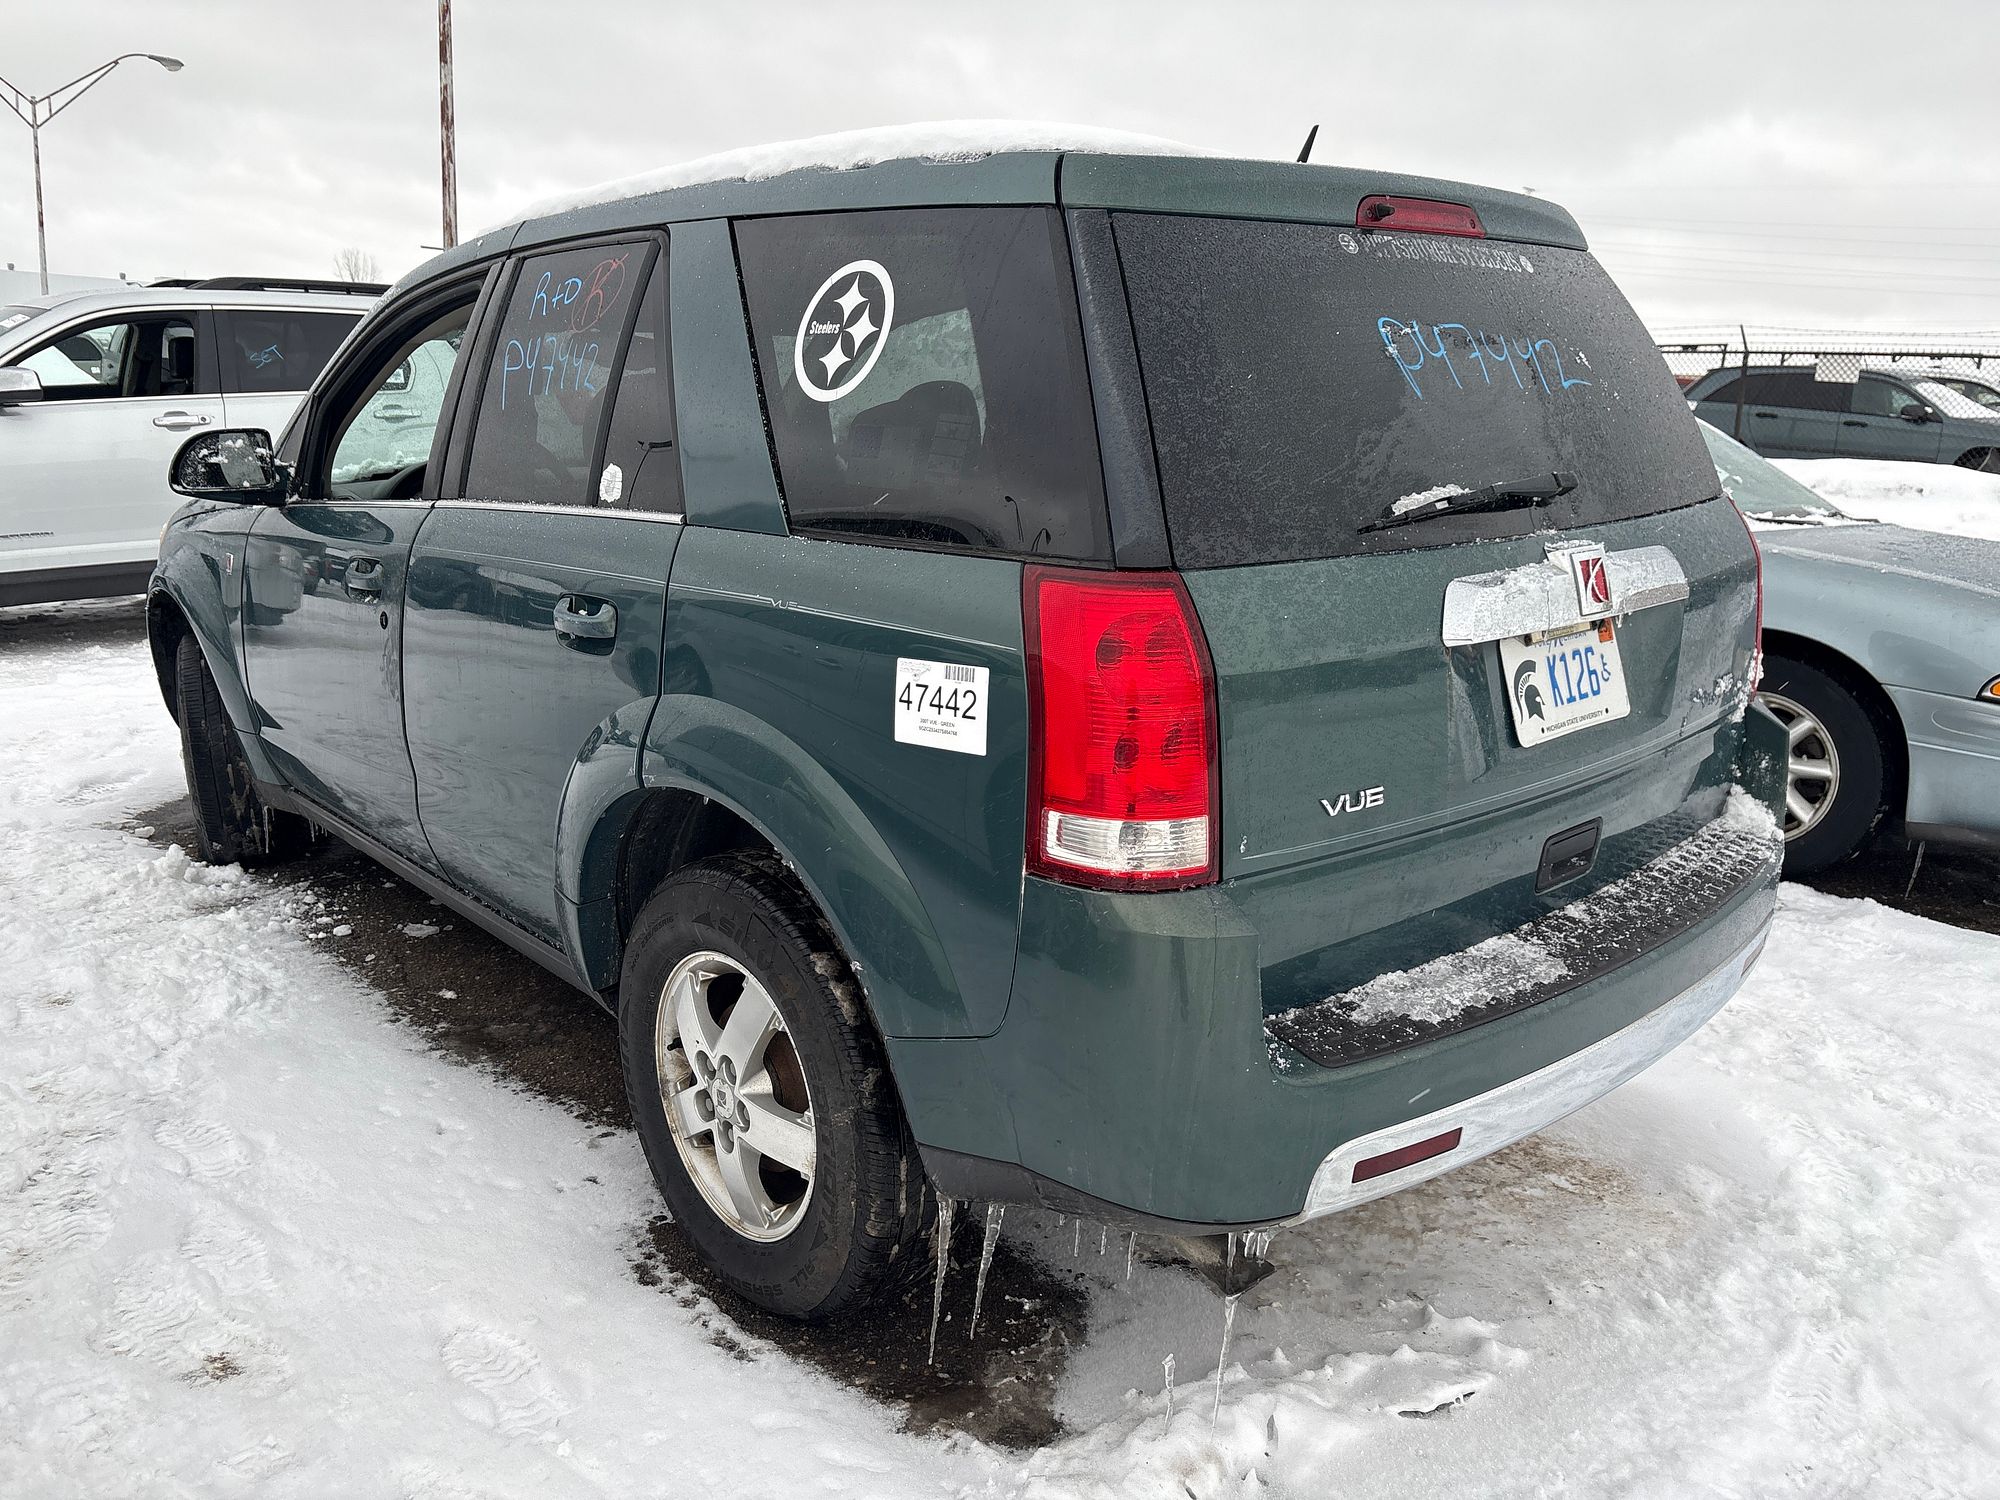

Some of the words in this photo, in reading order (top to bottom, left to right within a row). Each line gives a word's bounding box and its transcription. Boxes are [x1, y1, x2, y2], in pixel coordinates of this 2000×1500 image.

[809, 320, 841, 335] Steelers
[501, 336, 599, 411] P47442
[1545, 646, 1601, 708] K126
[898, 682, 977, 720] 47442
[1546, 722, 1567, 733] MICHIGAN
[1566, 716, 1579, 726] STATE
[1579, 710, 1604, 722] UNIVERSITY
[1319, 785, 1385, 817] VUE
